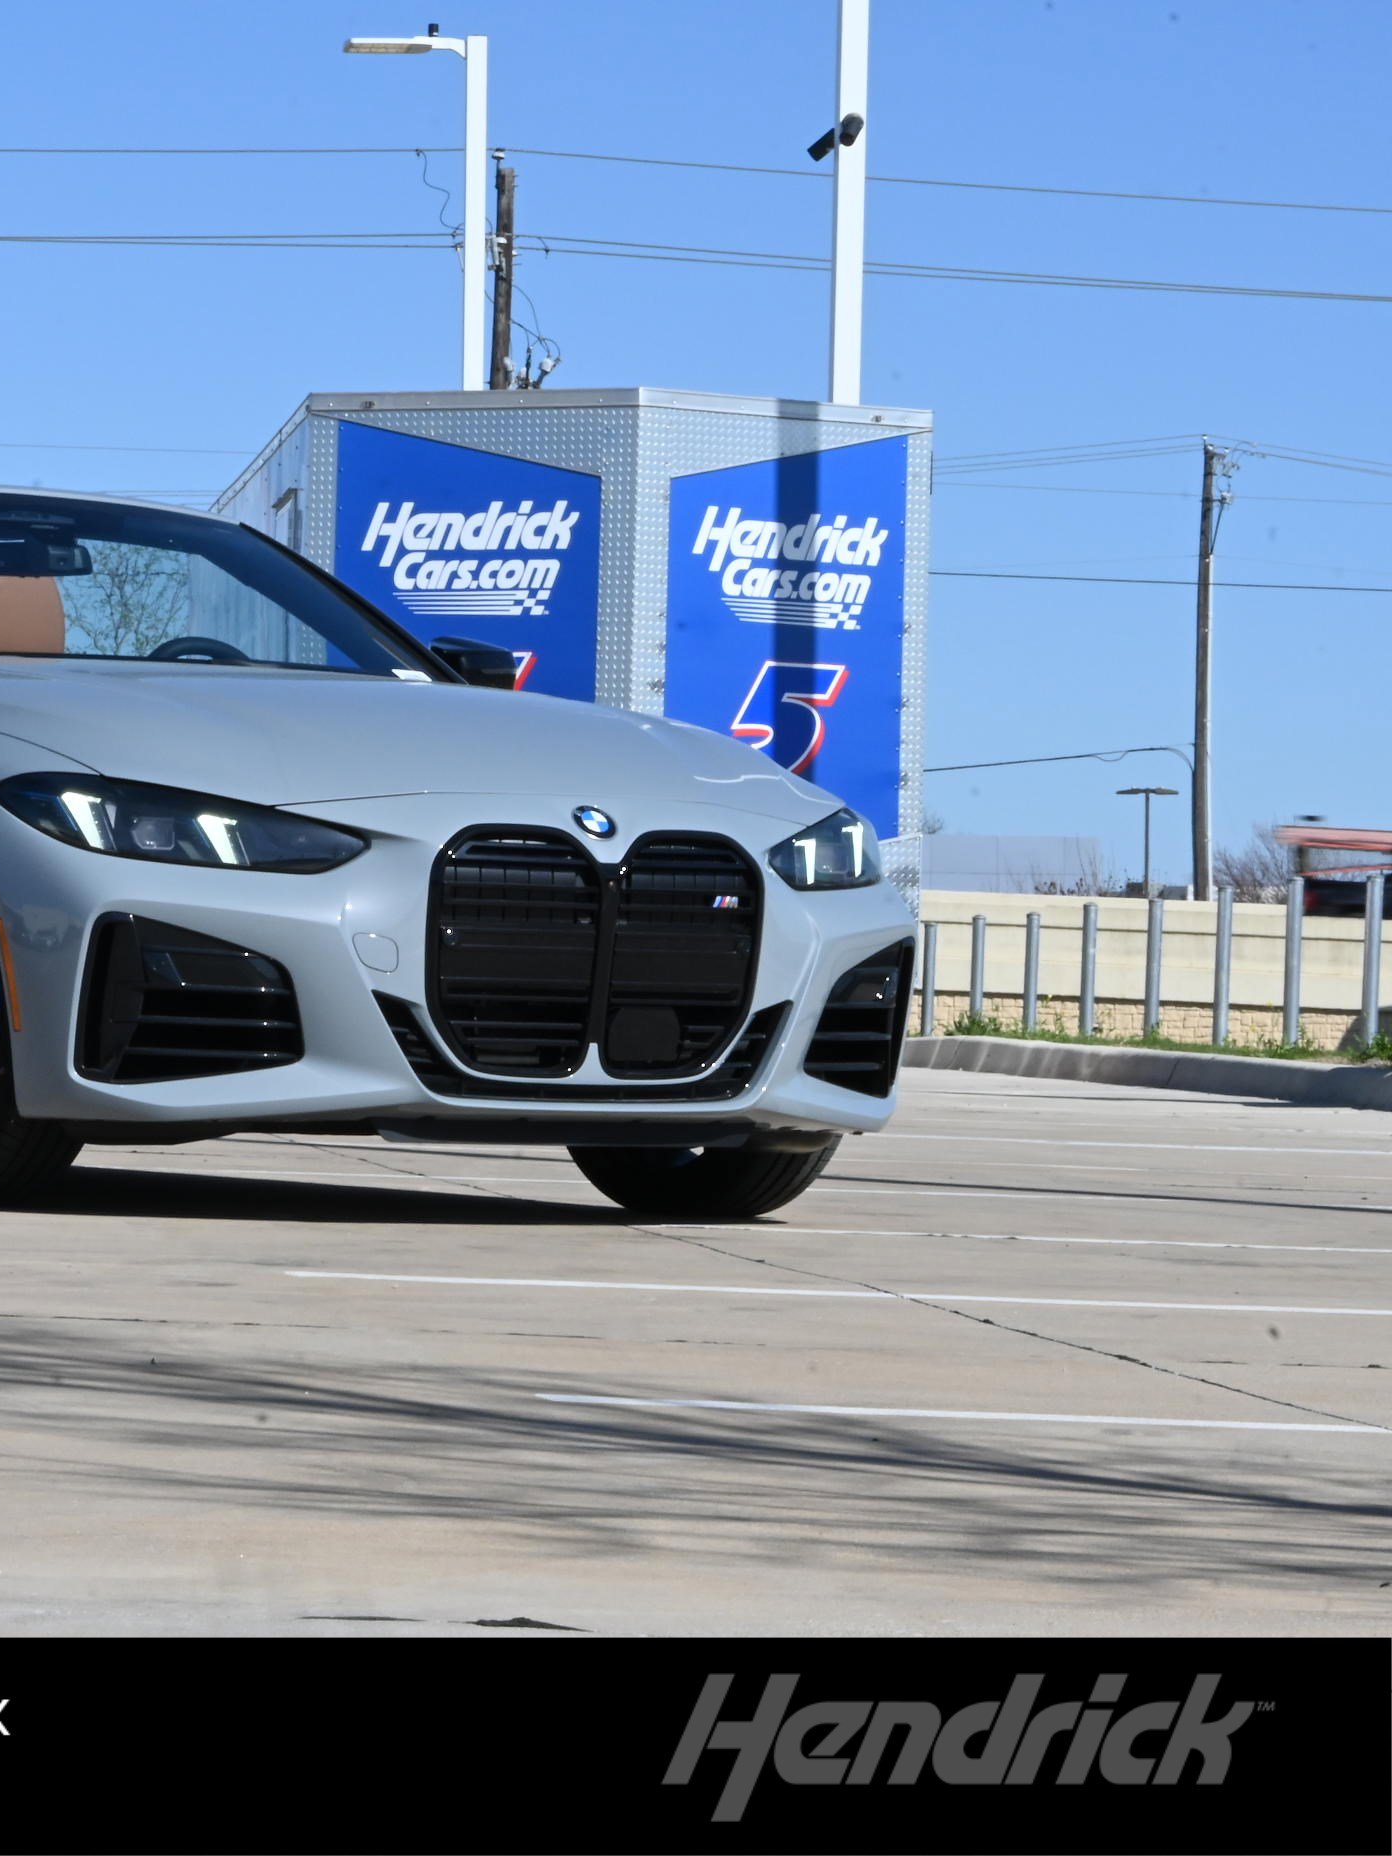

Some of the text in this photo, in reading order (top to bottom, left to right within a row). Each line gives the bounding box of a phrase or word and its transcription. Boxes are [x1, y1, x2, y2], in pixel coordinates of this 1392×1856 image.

[361, 500, 580, 567] Hendrick
[692, 505, 889, 571] Hendrick
[393, 552, 561, 590] Cars.com
[722, 559, 872, 604] Cars.com
[730, 660, 850, 775] 5
